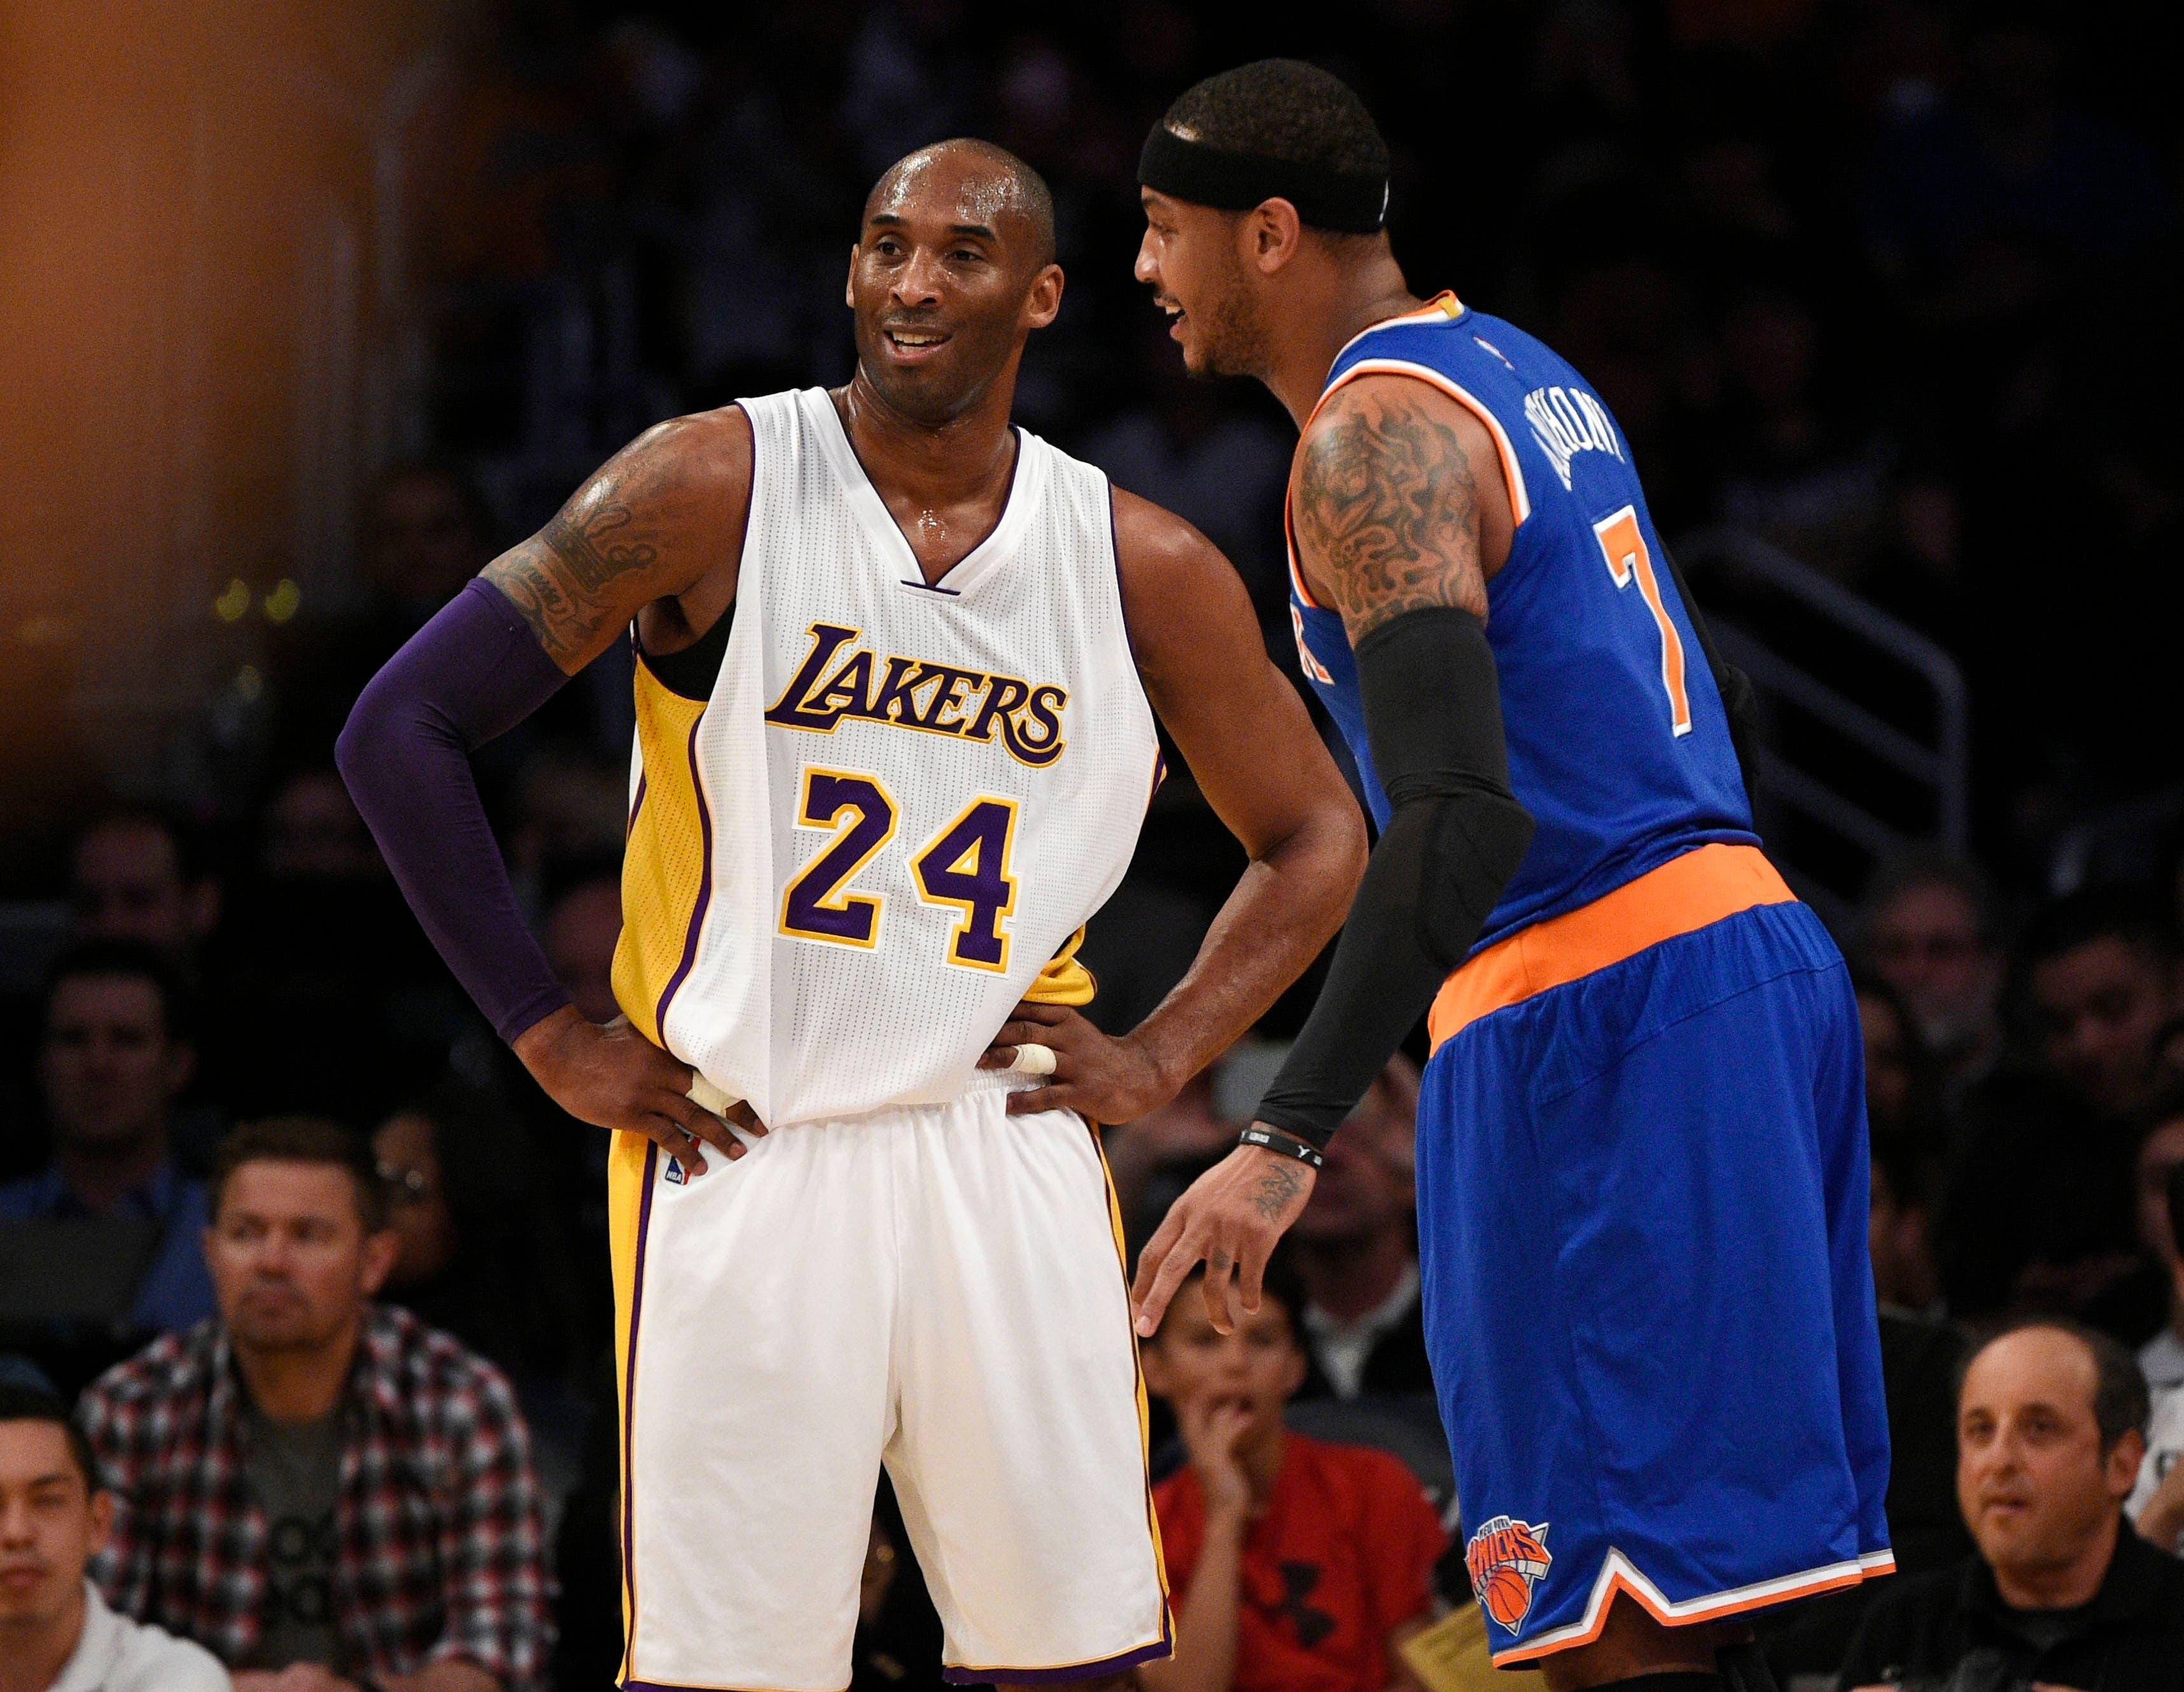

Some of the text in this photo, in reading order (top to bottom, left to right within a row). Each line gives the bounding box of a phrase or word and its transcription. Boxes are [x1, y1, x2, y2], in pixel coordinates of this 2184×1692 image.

[764, 619, 1070, 769] LAKERS
[1593, 505, 1692, 738] 7
[776, 764, 1021, 976] 24
[666, 1170, 682, 1182] NBA
[1468, 1523, 1550, 1584] KNICKS
